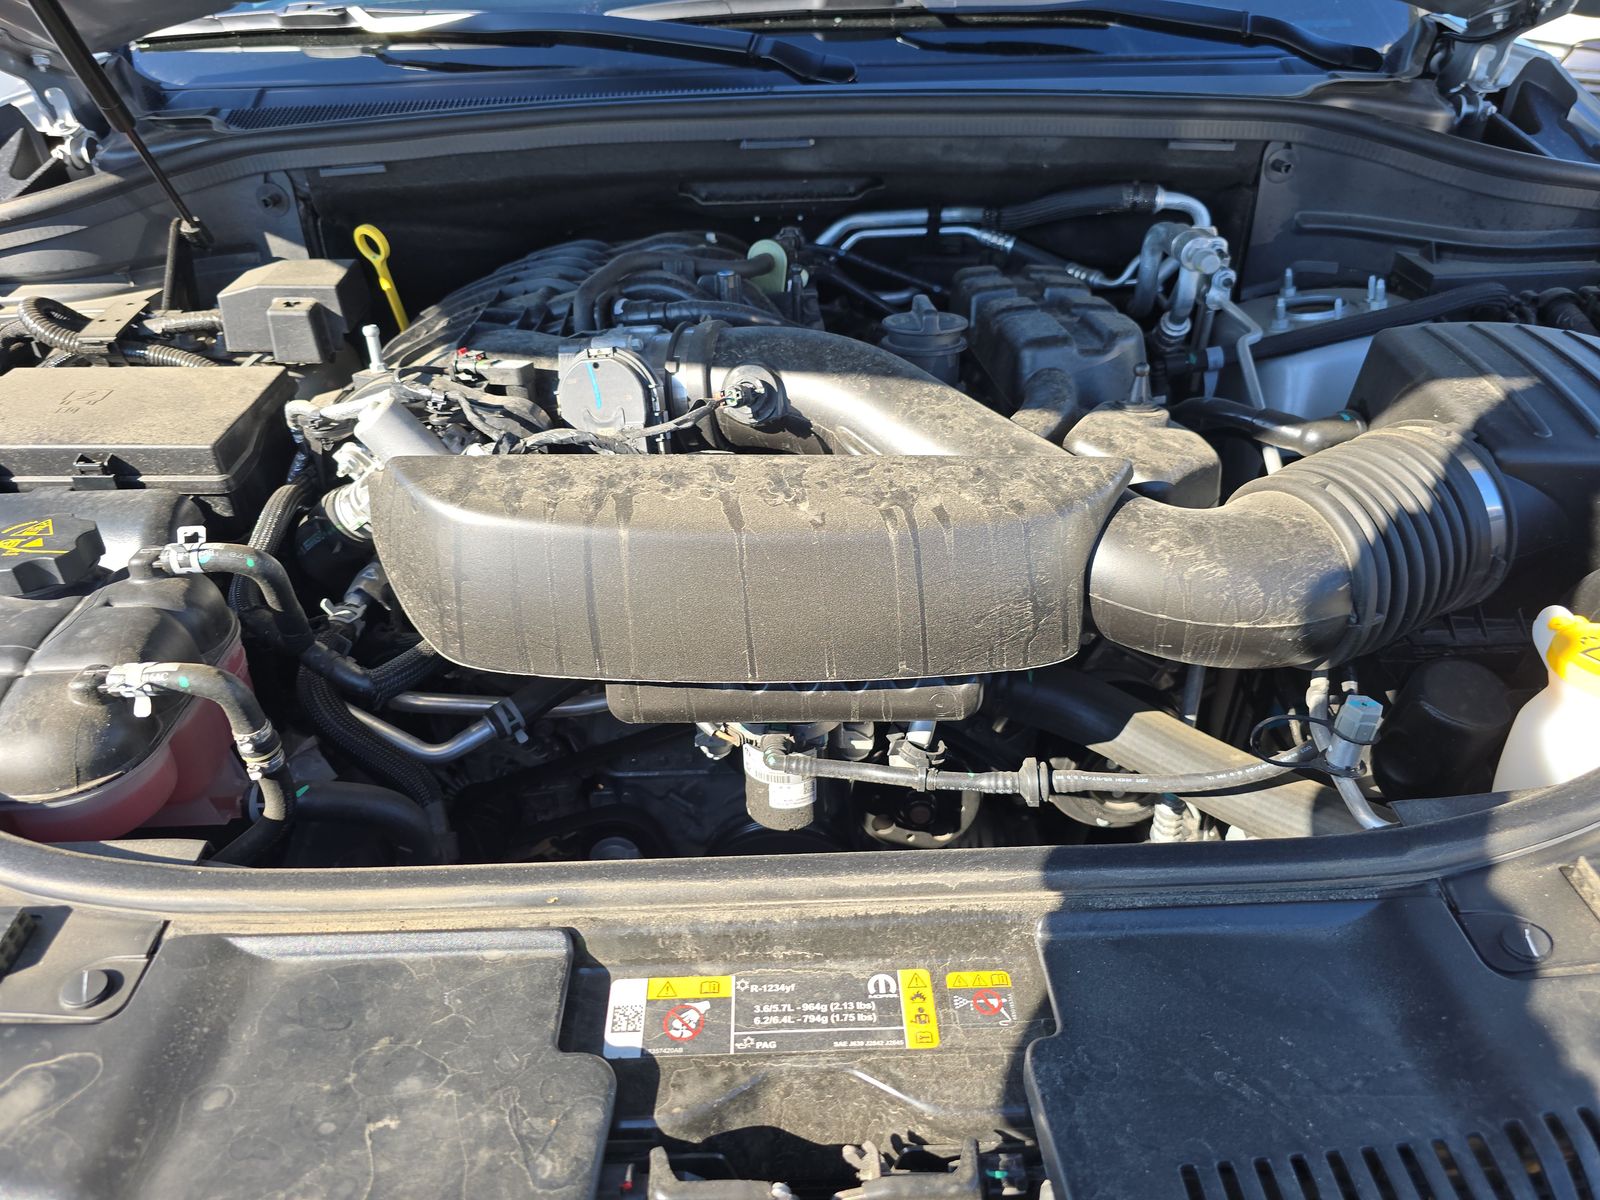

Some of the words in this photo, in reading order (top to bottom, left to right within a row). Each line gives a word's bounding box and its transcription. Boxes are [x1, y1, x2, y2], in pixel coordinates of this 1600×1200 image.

[750, 983, 796, 994] R-1234yf
[753, 1003, 795, 1013] 3.6/5.7L
[801, 1002, 828, 1013] 964g
[830, 1001, 854, 1012] (2.13
[855, 1000, 876, 1011] lbs)
[753, 1015, 795, 1025] 6.2/6.4L
[801, 1014, 829, 1025] 794g
[830, 1012, 856, 1024] (1.75
[856, 1012, 877, 1023] lbs)
[755, 1041, 777, 1049] PAG
